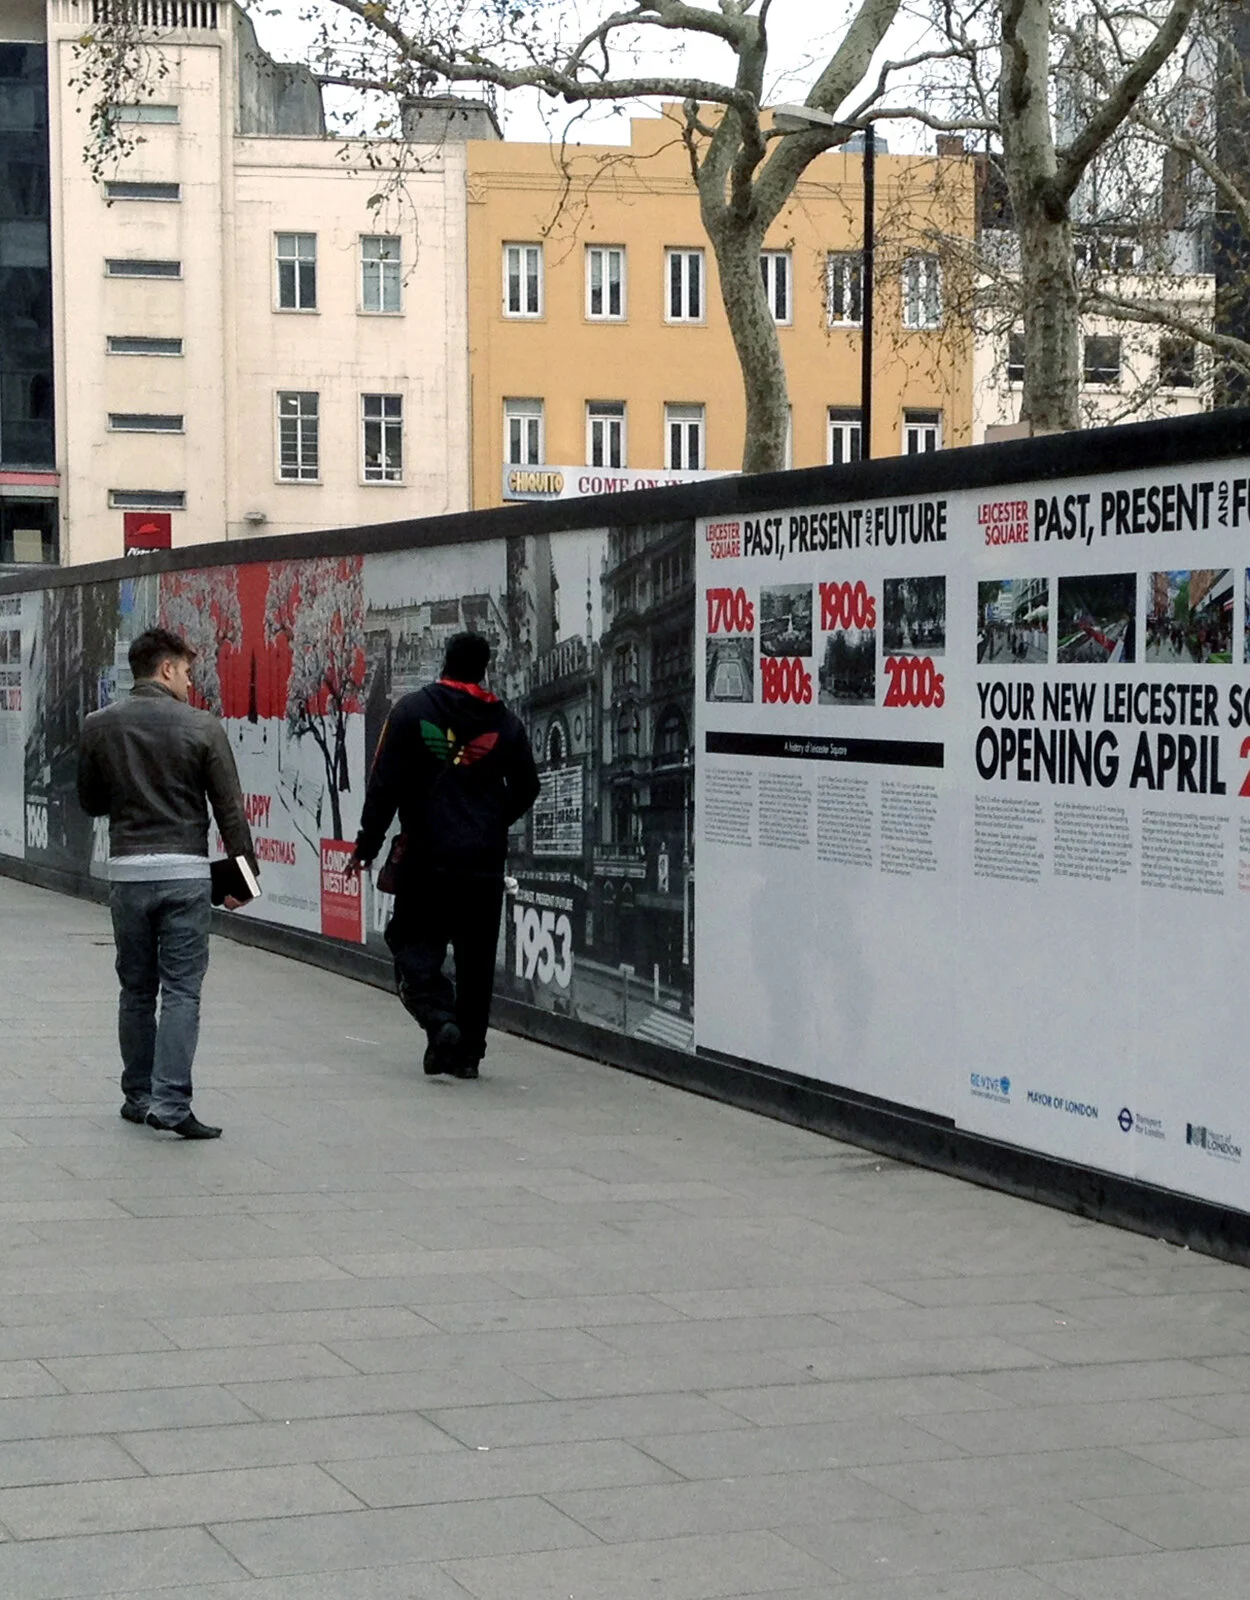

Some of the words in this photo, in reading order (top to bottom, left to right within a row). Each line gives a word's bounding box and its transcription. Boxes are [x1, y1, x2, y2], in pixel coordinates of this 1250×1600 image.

[510, 470, 564, 495] CHIQUITO
[578, 476, 629, 494] COME
[705, 522, 740, 542] LEICESTER
[743, 518, 786, 560] PAST,
[789, 509, 863, 553] PRESENT
[865, 508, 873, 545] AND
[874, 500, 947, 546] FUTURE
[977, 500, 1029, 526] LEICESTER
[1034, 492, 1095, 546] PAST,
[1101, 481, 1214, 538] PRESENT
[1217, 480, 1229, 526] AND
[710, 541, 741, 559] SQUARE
[985, 521, 1029, 546] SQUARE
[705, 587, 754, 634] 1700s
[818, 580, 876, 631] 1900s
[760, 656, 813, 704] 1800s
[882, 656, 945, 708] 2000s
[977, 681, 1035, 721] YOUR
[1042, 682, 1096, 723] NEW
[1103, 683, 1219, 727] LEICESTER
[975, 725, 1120, 789] OPENING
[1129, 730, 1227, 796] APRIL
[255, 836, 296, 866] CHRISTMAS
[322, 848, 352, 873] LONDO
[513, 904, 572, 989] 1953
[1027, 1090, 1052, 1108] MAYOR
[1053, 1098, 1064, 1110] OF
[1065, 1100, 1099, 1118] LONDON
[1207, 1140, 1242, 1157] LONDON
